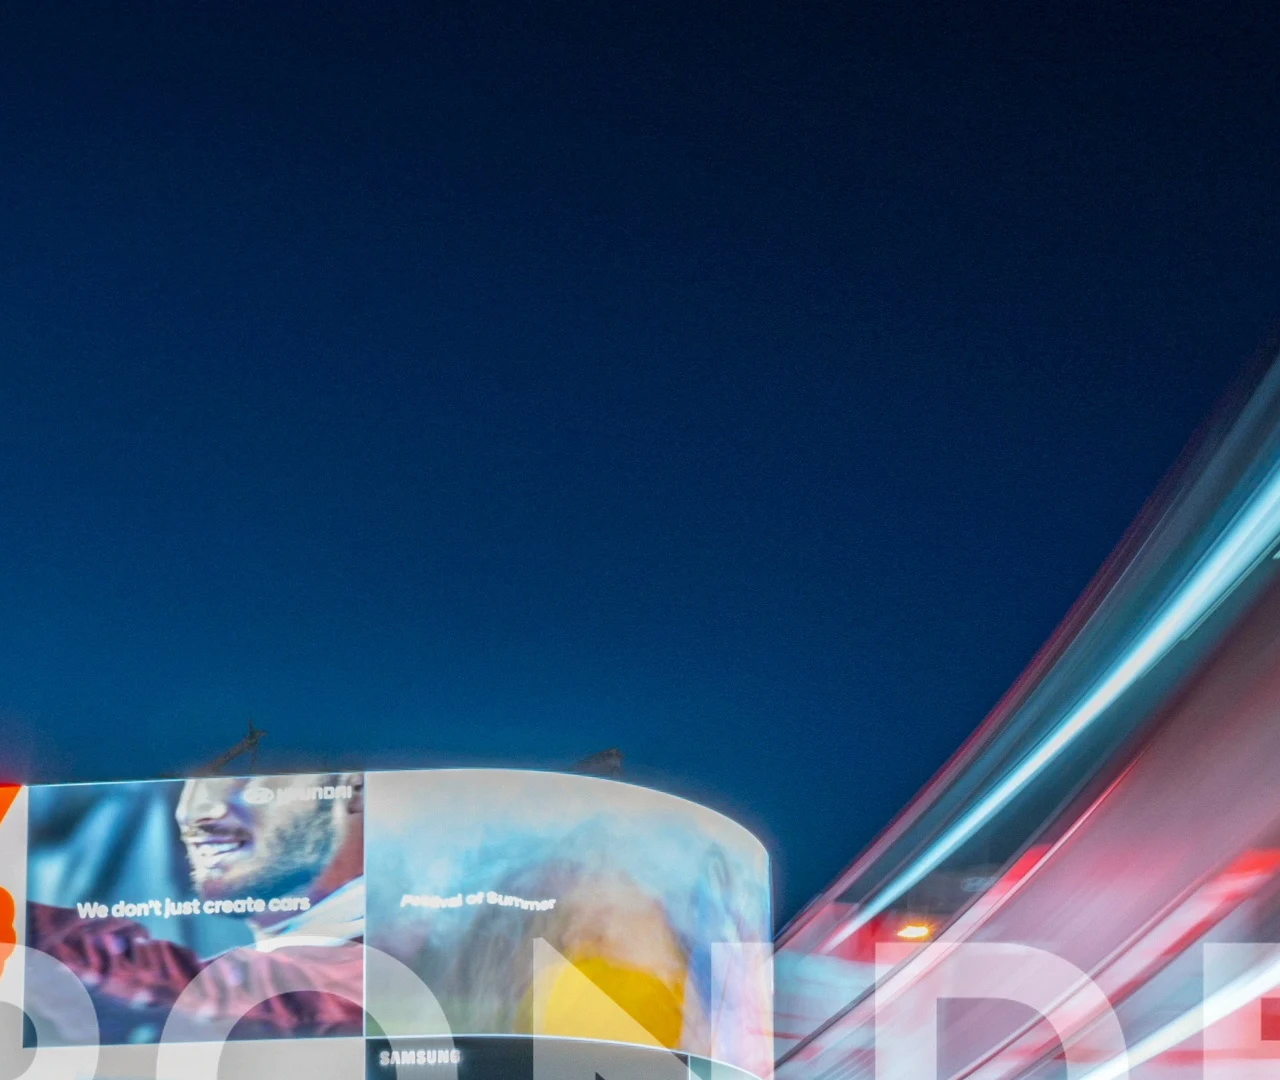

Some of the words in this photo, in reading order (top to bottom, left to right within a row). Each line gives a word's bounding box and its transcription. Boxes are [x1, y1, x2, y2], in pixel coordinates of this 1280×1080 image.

[275, 785, 352, 801] HUNDAI
[77, 902, 108, 919] We
[111, 900, 162, 918] don't
[163, 897, 201, 919] just
[203, 897, 266, 914] create
[268, 897, 310, 912] cars
[465, 891, 484, 905] of
[486, 890, 557, 911] Summer
[380, 1048, 461, 1066] SAMSUNG
